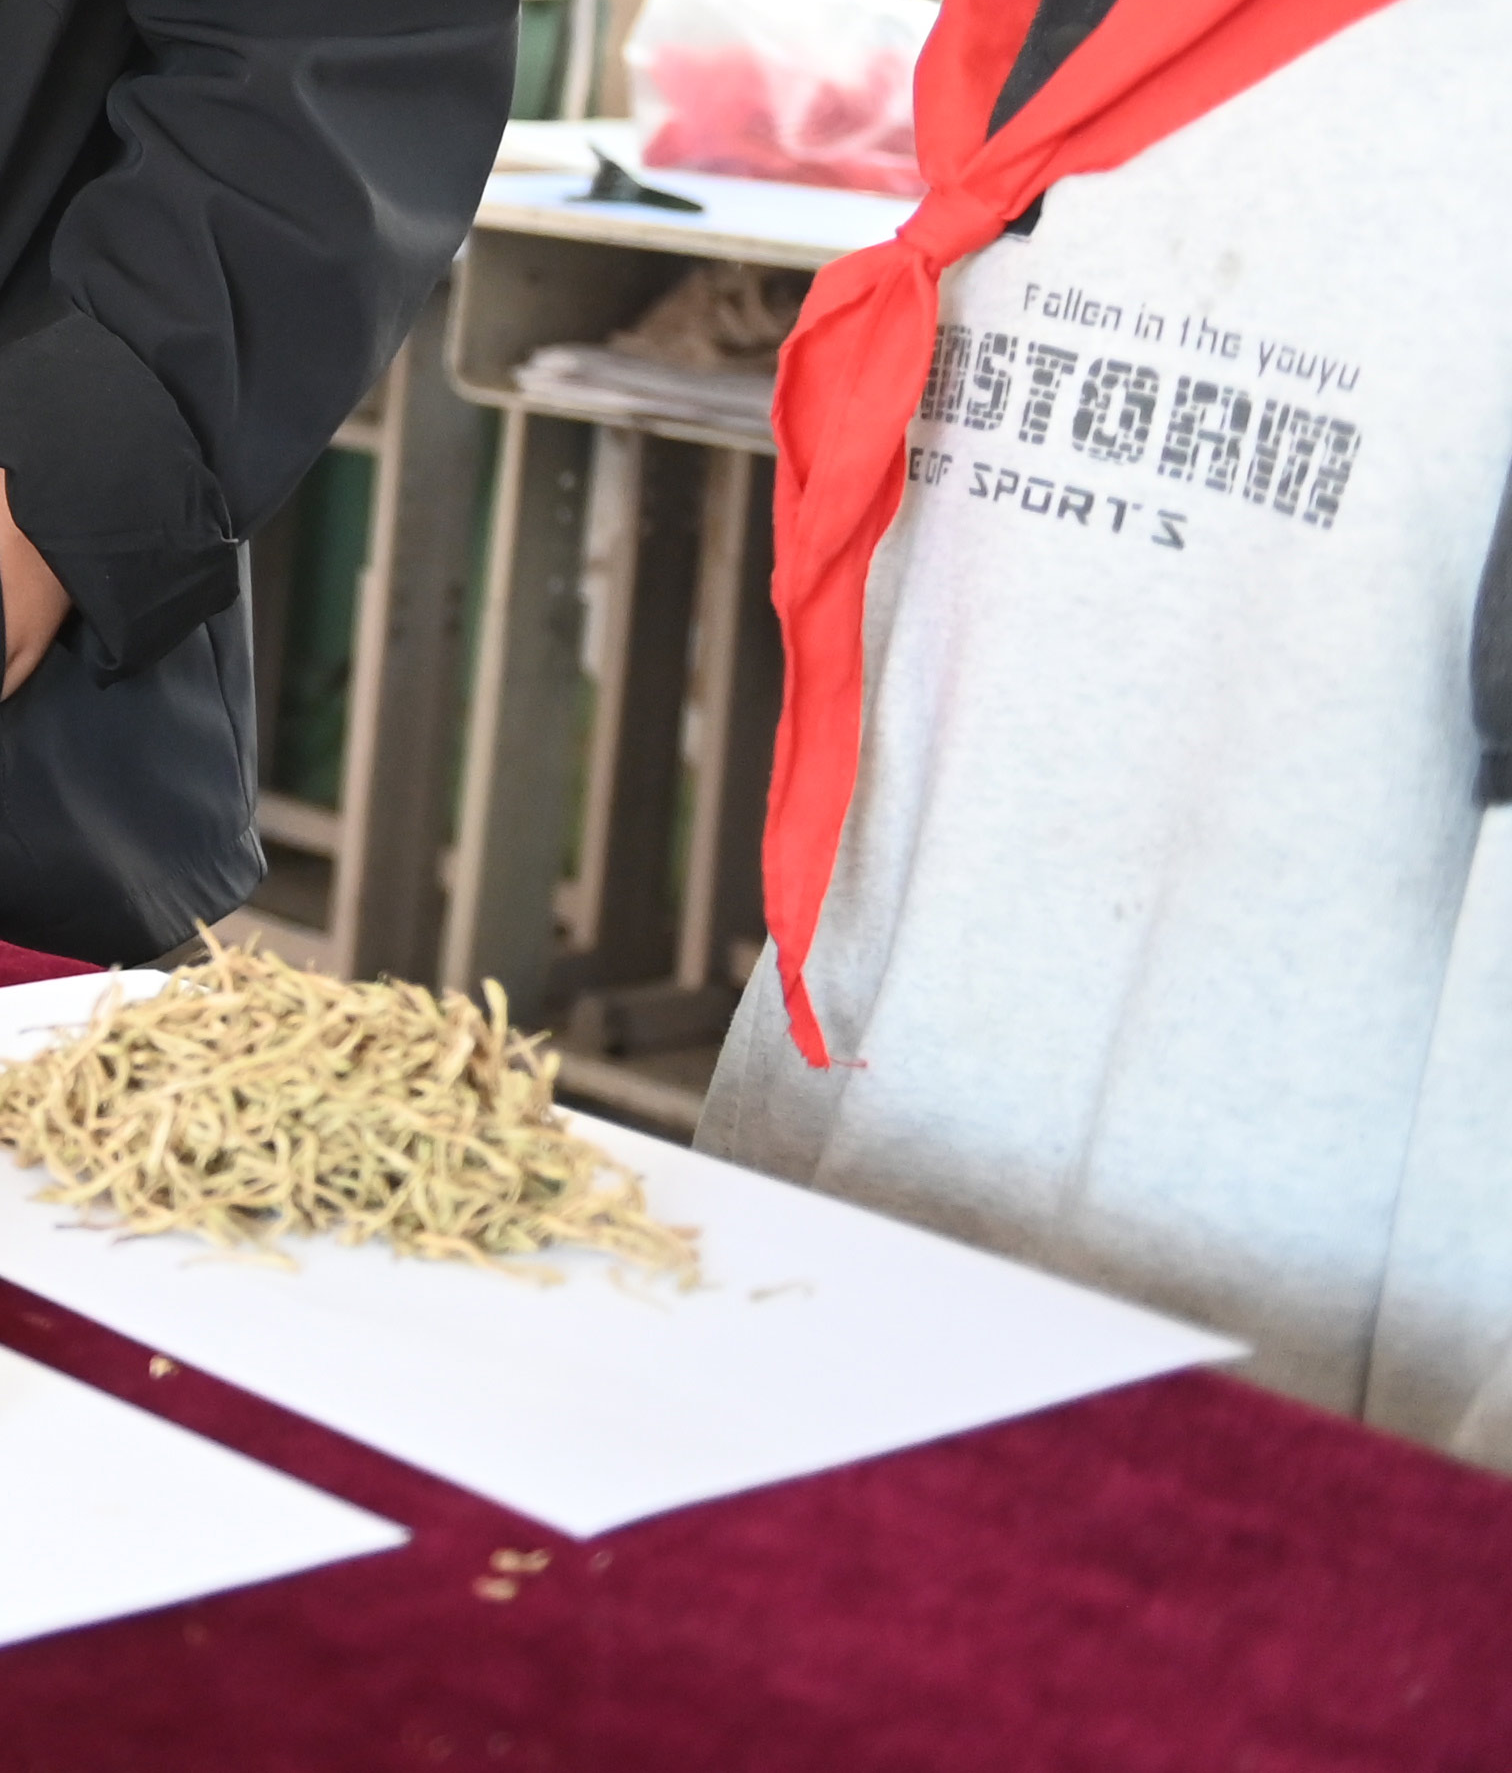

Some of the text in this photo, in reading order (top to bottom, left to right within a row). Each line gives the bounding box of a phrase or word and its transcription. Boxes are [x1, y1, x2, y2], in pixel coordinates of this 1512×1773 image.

[1023, 282, 1122, 332] Fallen
[1135, 303, 1164, 342] in
[1180, 316, 1241, 359] the
[969, 461, 1188, 551] SPORTS
